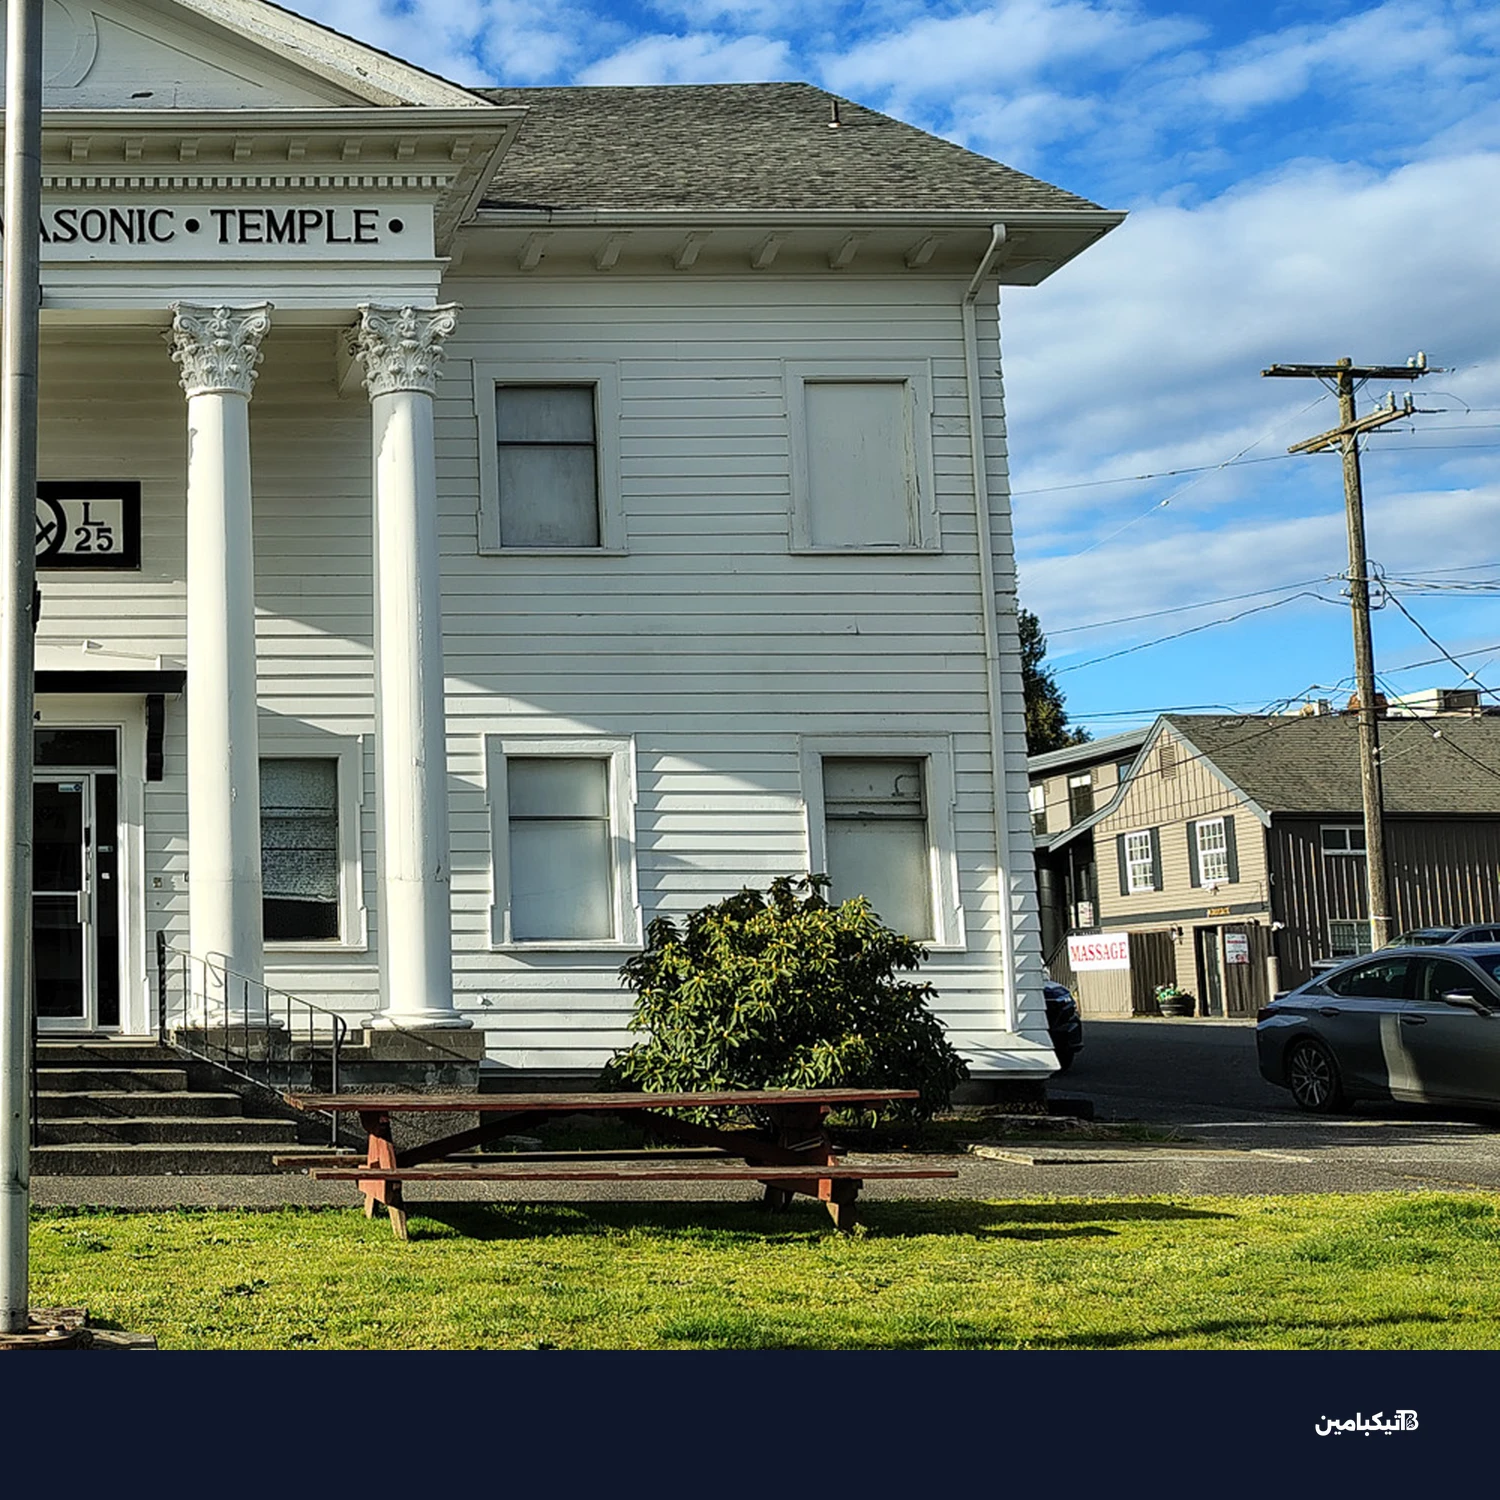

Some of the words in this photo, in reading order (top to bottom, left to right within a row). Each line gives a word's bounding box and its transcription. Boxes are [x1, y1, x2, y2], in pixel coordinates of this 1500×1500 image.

[210, 209, 381, 245] TEMPLE
[82, 502, 105, 527] L
[74, 527, 114, 552] 25
[1070, 941, 1127, 962] MASSAGE
